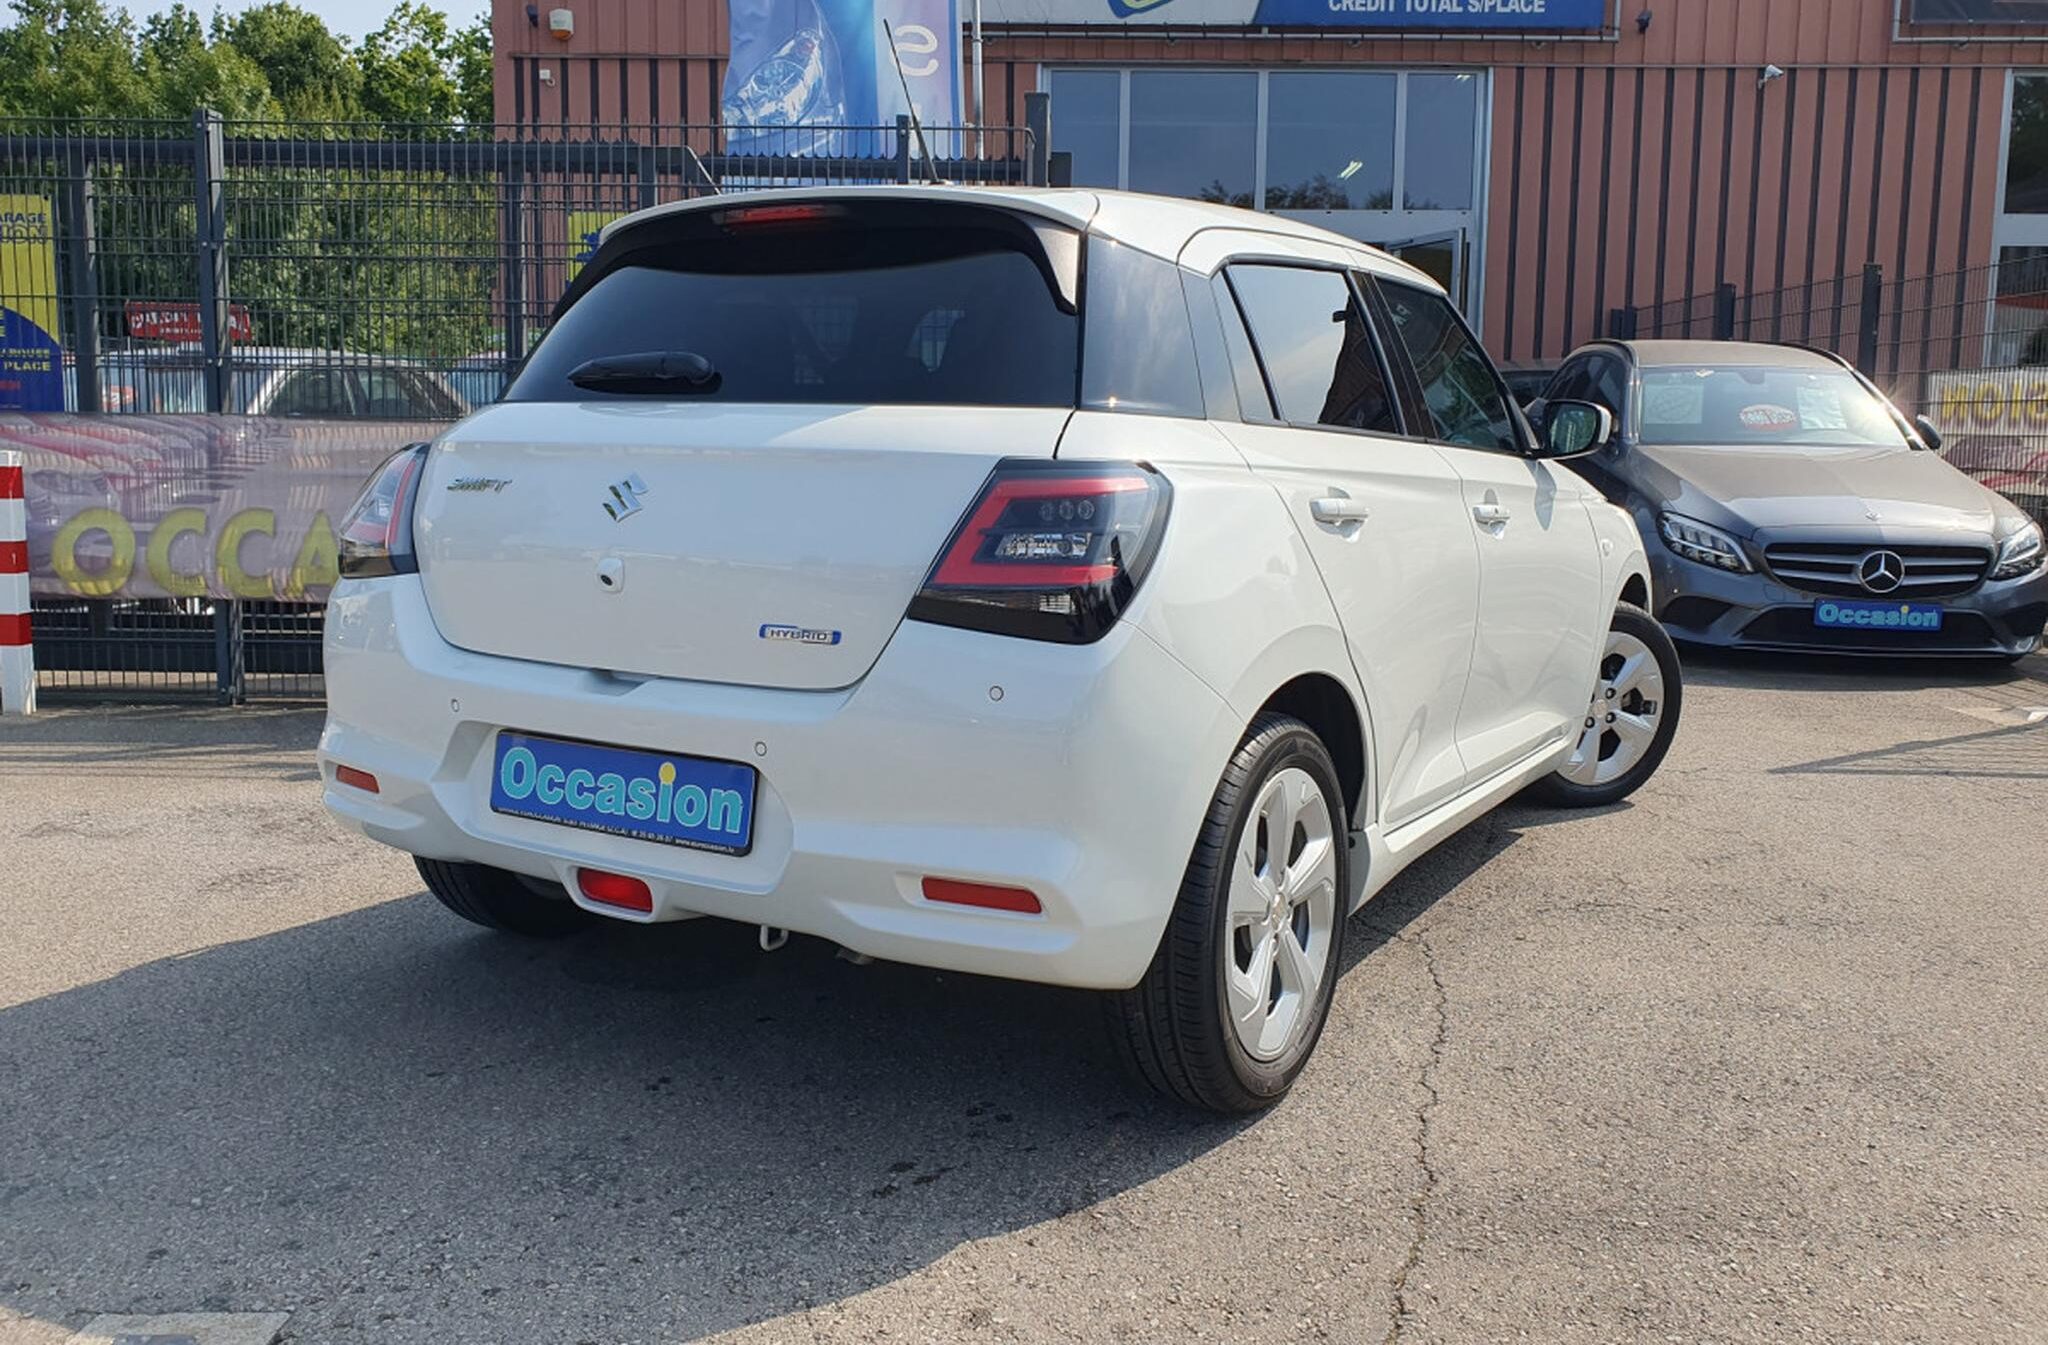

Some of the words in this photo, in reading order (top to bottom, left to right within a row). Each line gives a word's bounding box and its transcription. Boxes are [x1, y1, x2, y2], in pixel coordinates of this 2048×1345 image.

[1328, 0, 1395, 11] CREDIT
[1405, 0, 1462, 12] TOTAL
[0, 212, 46, 223] RAGE
[4, 361, 51, 371] PLACE
[1819, 603, 1938, 627] Occasion
[770, 629, 828, 641] HYBRID
[501, 746, 743, 834] Occasion
